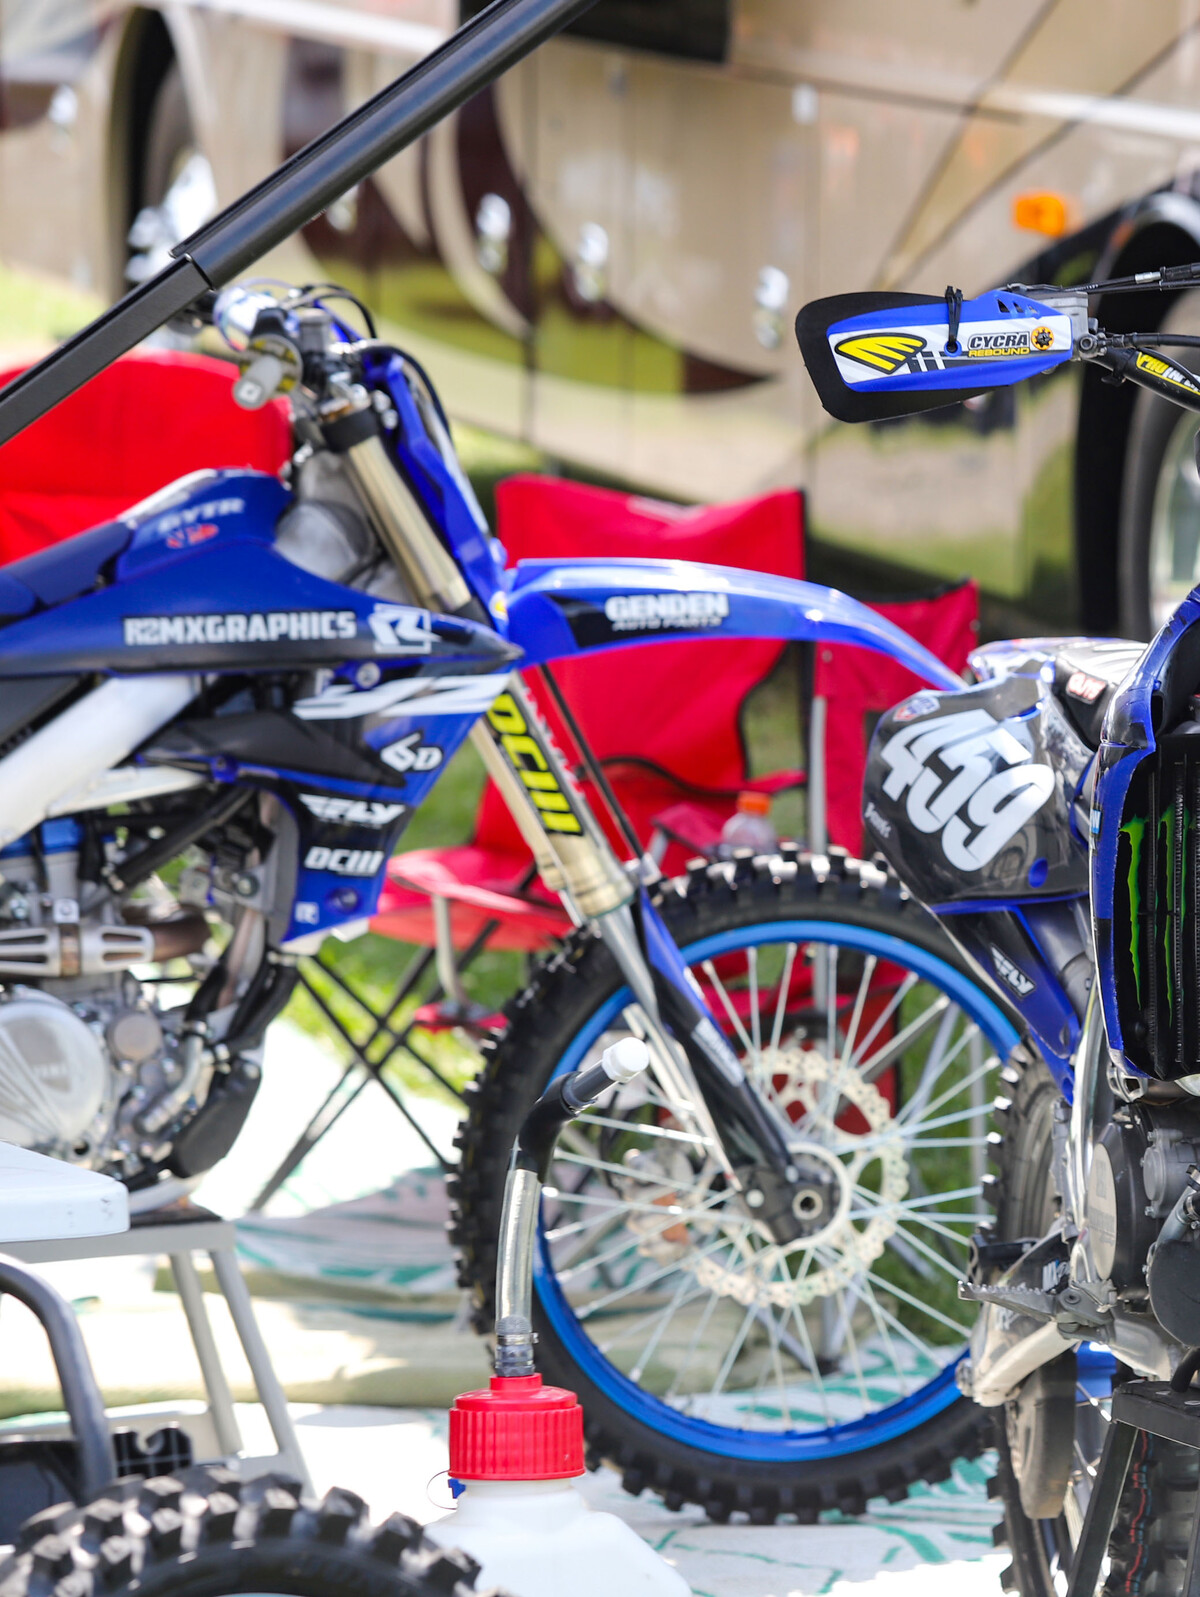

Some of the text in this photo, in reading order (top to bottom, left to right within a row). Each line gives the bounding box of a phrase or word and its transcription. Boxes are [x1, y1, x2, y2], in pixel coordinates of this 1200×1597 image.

[968, 347, 1030, 358] REBOUND
[970, 333, 1029, 349] CYCRA
[605, 594, 729, 622] GENDEN
[123, 611, 357, 645] R2MXGRAPHICS
[881, 709, 1055, 871] 459
